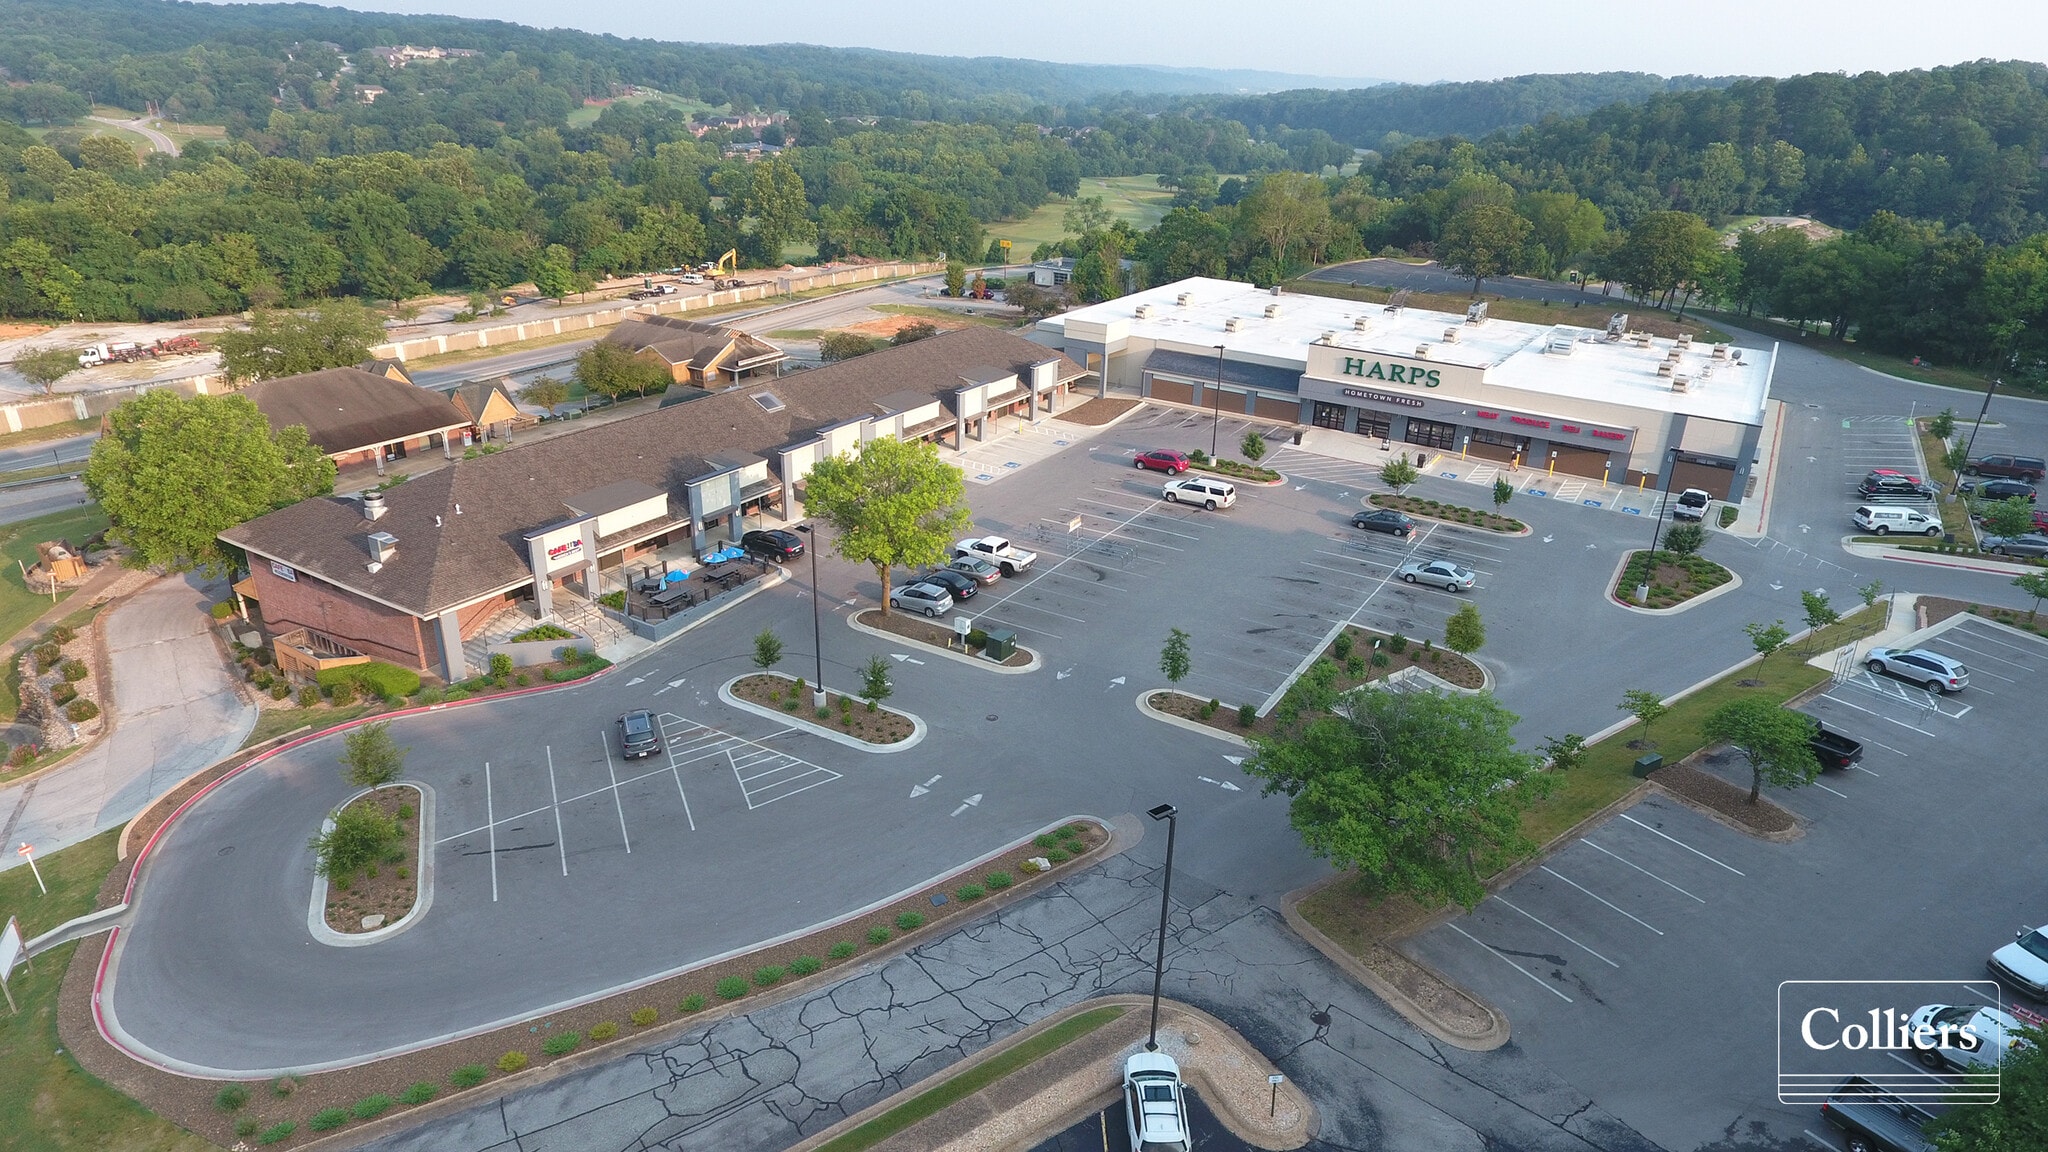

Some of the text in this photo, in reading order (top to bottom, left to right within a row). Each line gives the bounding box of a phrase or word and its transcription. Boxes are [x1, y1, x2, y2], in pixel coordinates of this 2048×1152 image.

[1343, 356, 1441, 388] HARPS
[1345, 389, 1423, 407] HOMETOWN FRESH
[1477, 410, 1627, 441] MEAT PRODUCE DELI BAKERY
